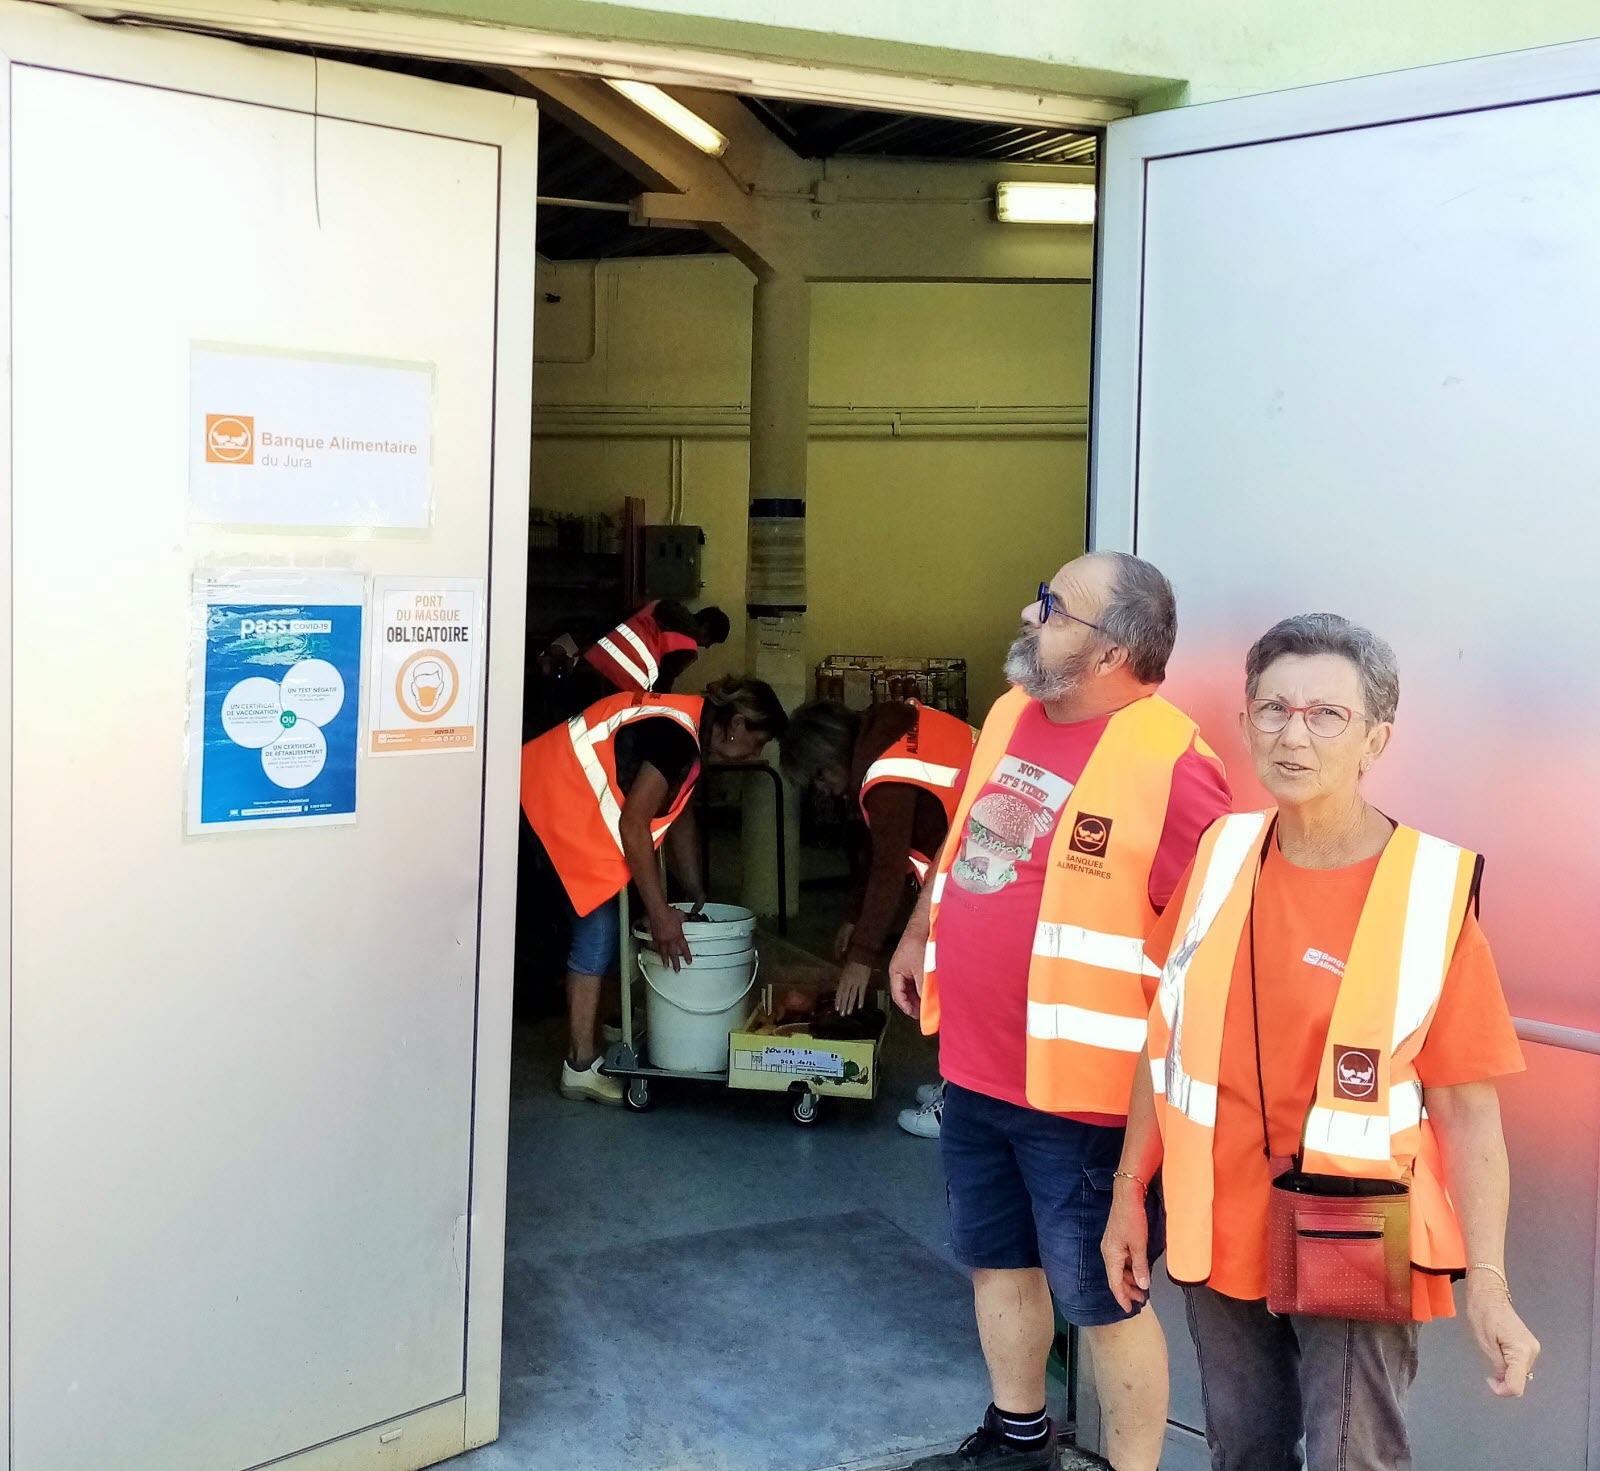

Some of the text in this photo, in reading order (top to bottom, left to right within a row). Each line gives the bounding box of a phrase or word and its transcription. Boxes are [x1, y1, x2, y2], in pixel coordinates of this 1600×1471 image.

[262, 432, 417, 454] Banque Alimentaire
[262, 454, 312, 468] du Jura
[415, 595, 443, 608] PORT
[396, 609, 460, 622] DU MASQUE
[240, 619, 329, 639] pass COVID-19
[386, 626, 469, 643] OBLIGATOIRE
[312, 685, 337, 693] NÉGATIF
[281, 715, 295, 724] OU
[1017, 762, 1045, 781] NOW
[997, 773, 1021, 788] IT'S
